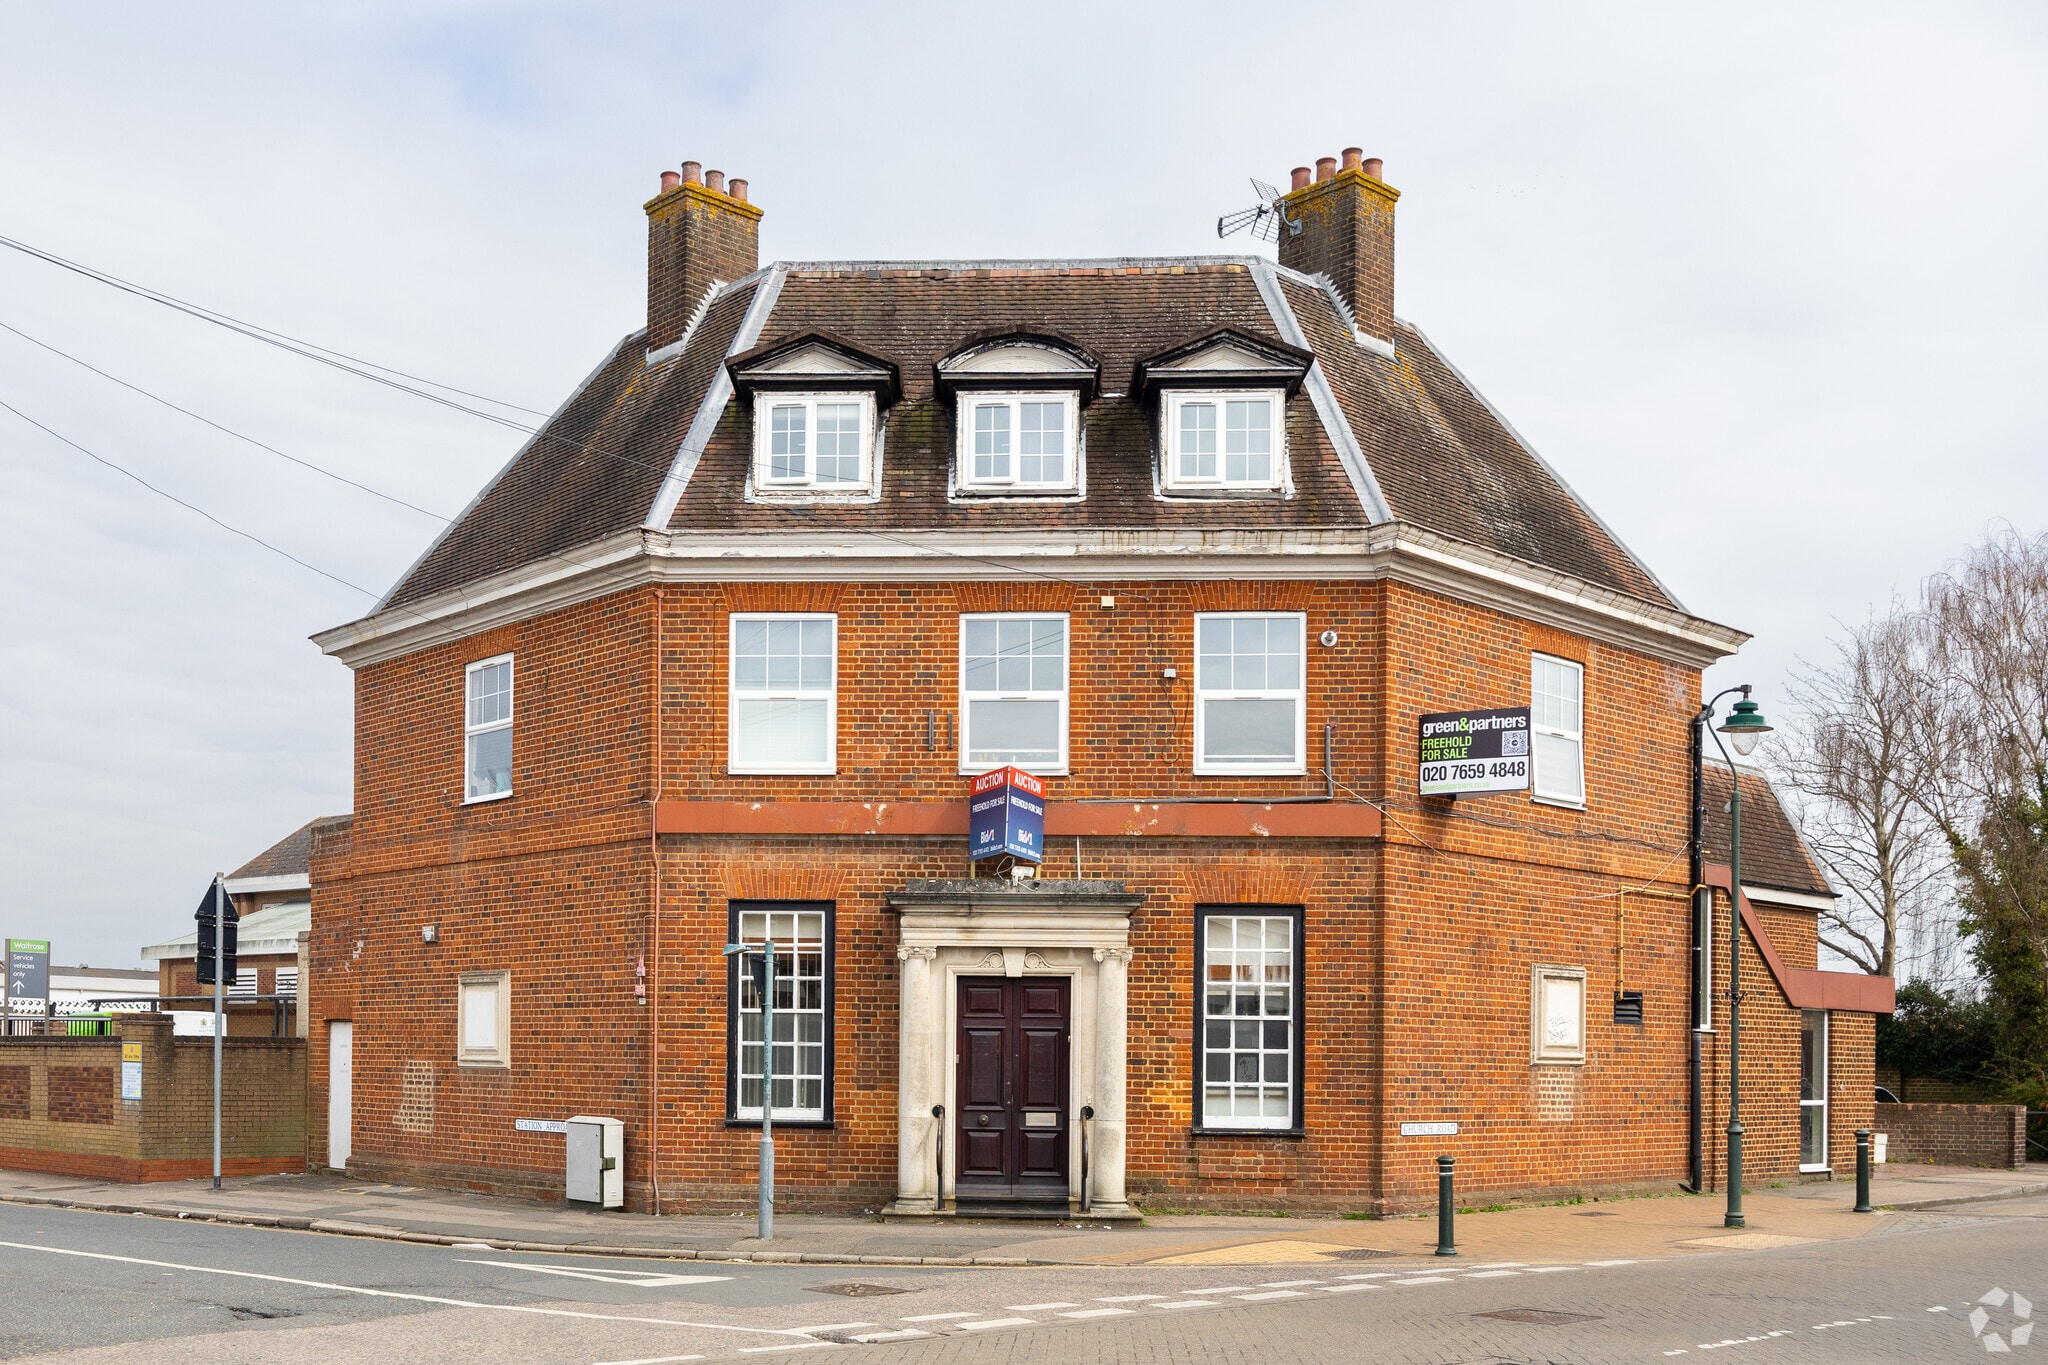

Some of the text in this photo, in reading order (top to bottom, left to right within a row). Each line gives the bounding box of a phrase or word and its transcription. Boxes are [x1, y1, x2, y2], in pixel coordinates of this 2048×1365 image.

[1422, 715, 1526, 737] green&partners
[1422, 736, 1472, 750] FREEHOLD
[1421, 747, 1468, 761] FOR SALE
[1422, 761, 1525, 782] 020 7659 4848
[975, 771, 1004, 792] AUCTION
[1014, 772, 1041, 794] AUCTION
[972, 801, 990, 813] FREEHOLD
[997, 795, 1006, 806] SALE
[1010, 795, 1028, 810] FREEHOLD
[1035, 805, 1043, 816] SALE
[14, 942, 45, 950] Waitrose
[517, 1120, 542, 1130] STATION
[1403, 1124, 1456, 1134] CHURCH ROAD
